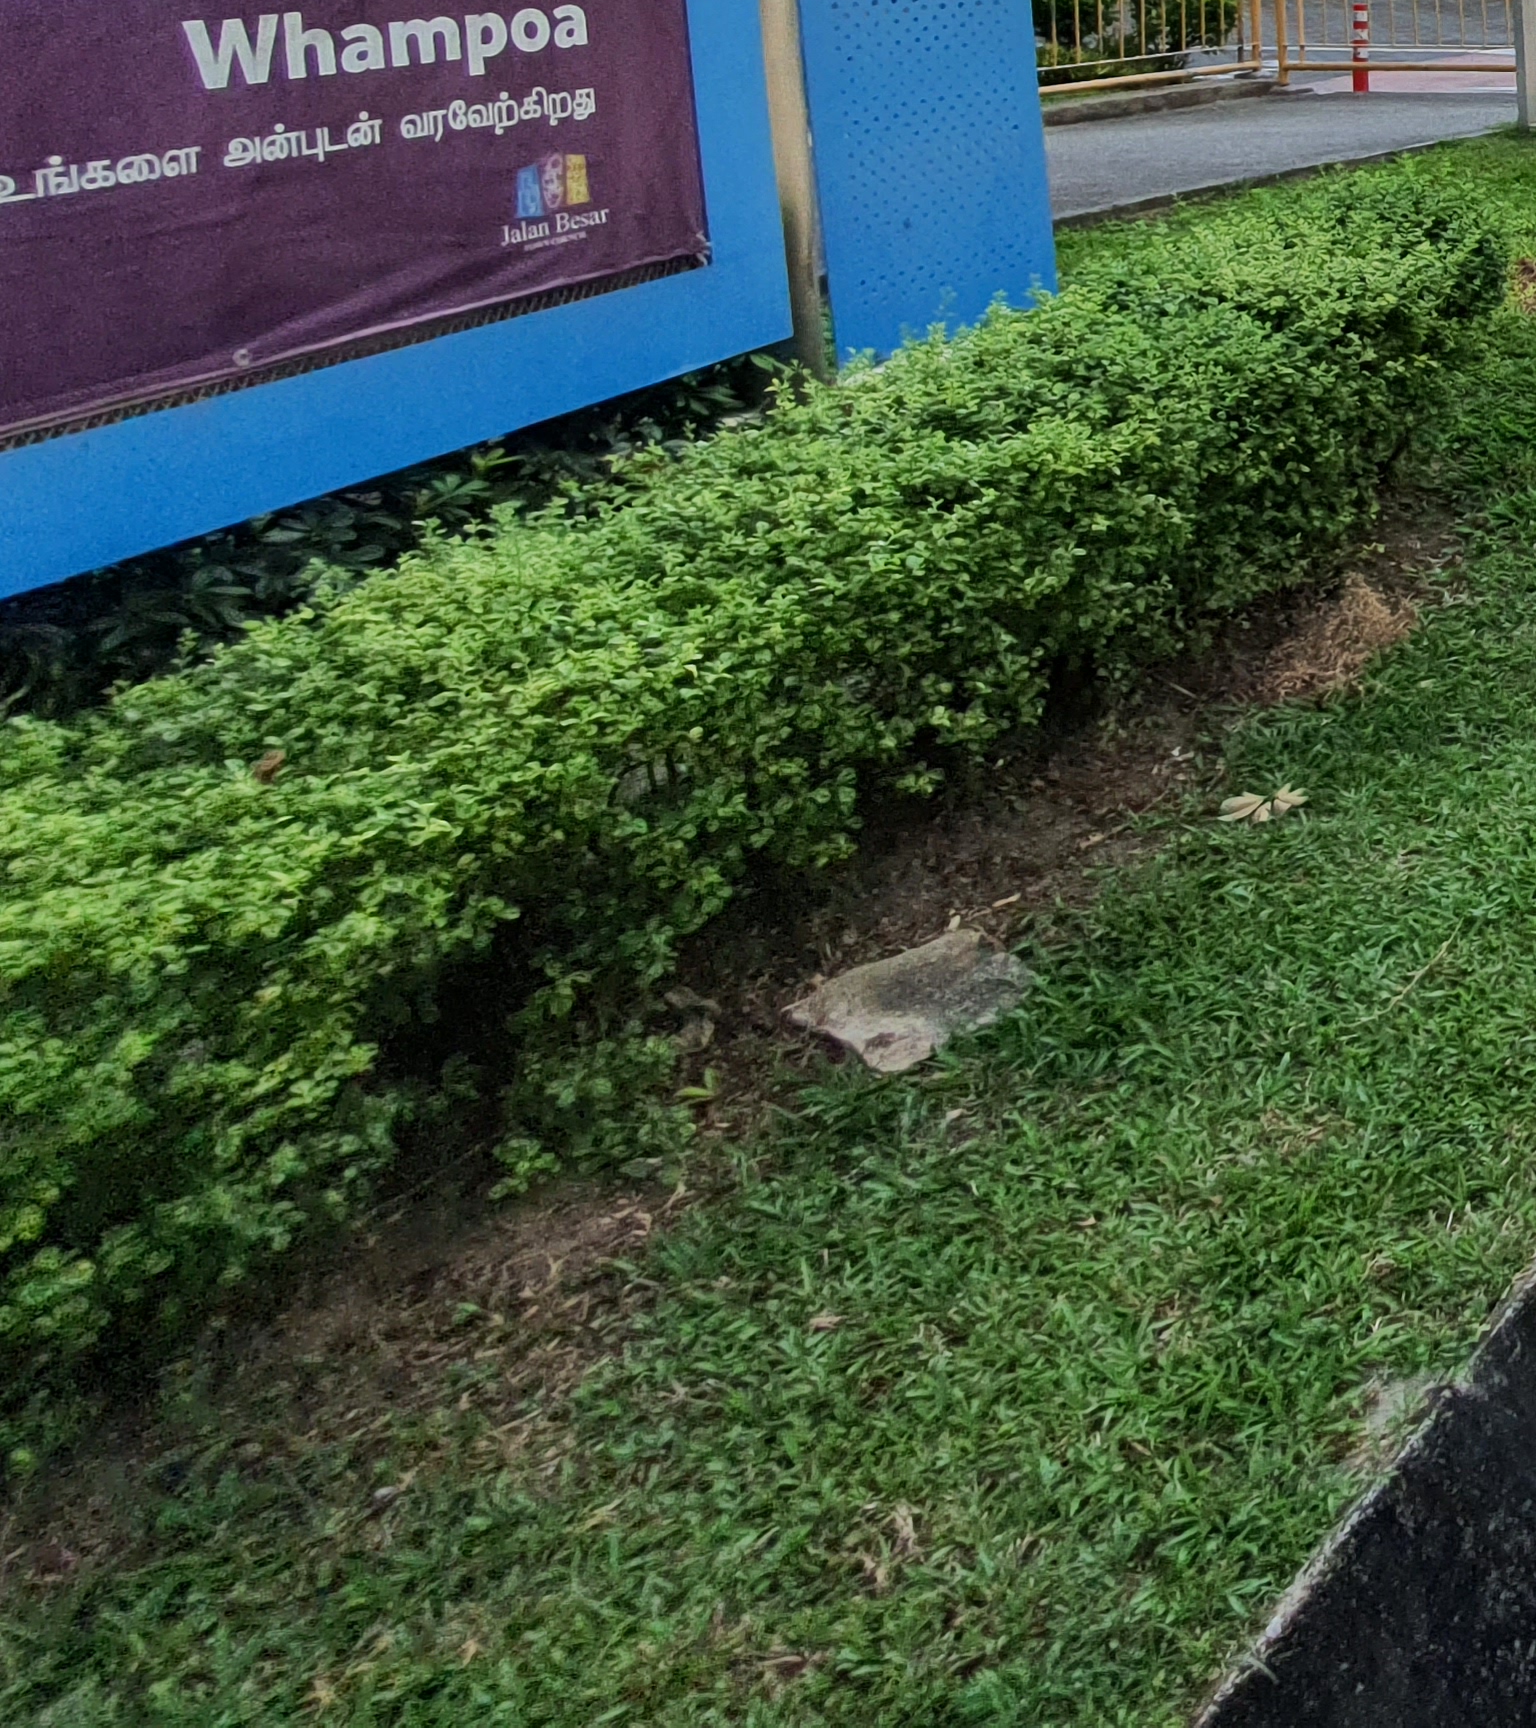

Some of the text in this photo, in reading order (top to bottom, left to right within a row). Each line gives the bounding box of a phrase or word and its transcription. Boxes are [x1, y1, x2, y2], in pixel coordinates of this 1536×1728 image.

[182, 4, 588, 90] Whampoa
[500, 221, 550, 247] Jalan
[555, 208, 609, 233] Besar
